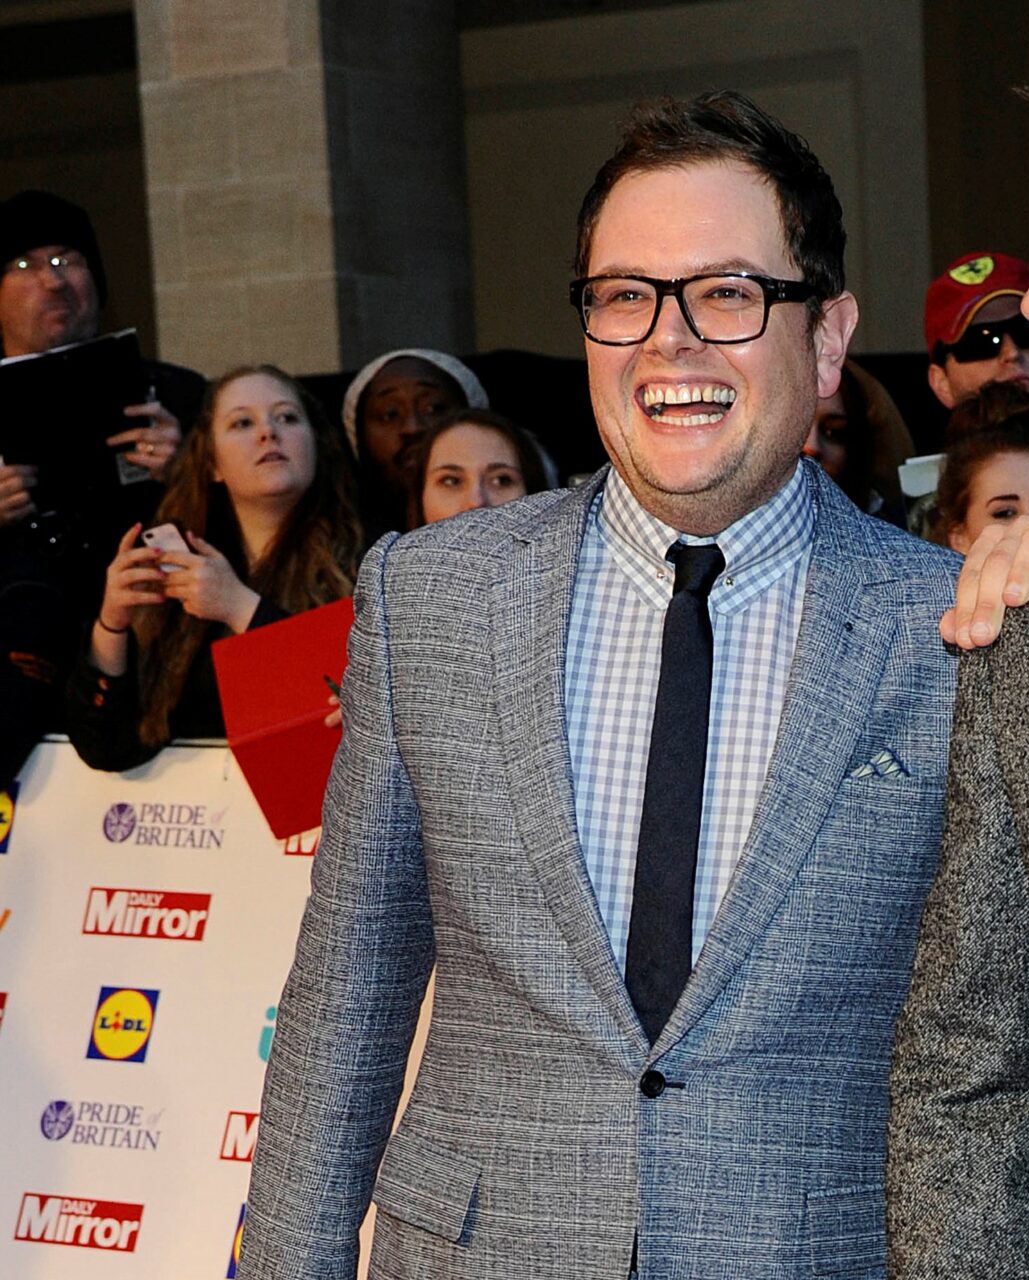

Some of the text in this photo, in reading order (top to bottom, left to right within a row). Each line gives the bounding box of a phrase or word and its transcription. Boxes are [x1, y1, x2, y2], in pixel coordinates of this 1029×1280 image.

[139, 803, 207, 825] PRIDE
[134, 826, 226, 850] BRITAIN
[129, 892, 164, 908] DAILY
[85, 890, 206, 938] Mirror
[76, 1102, 142, 1126] PRIDE
[71, 1125, 161, 1151] BRITAIN
[60, 1199, 96, 1217] DAILY
[17, 1196, 139, 1249] Mirror
